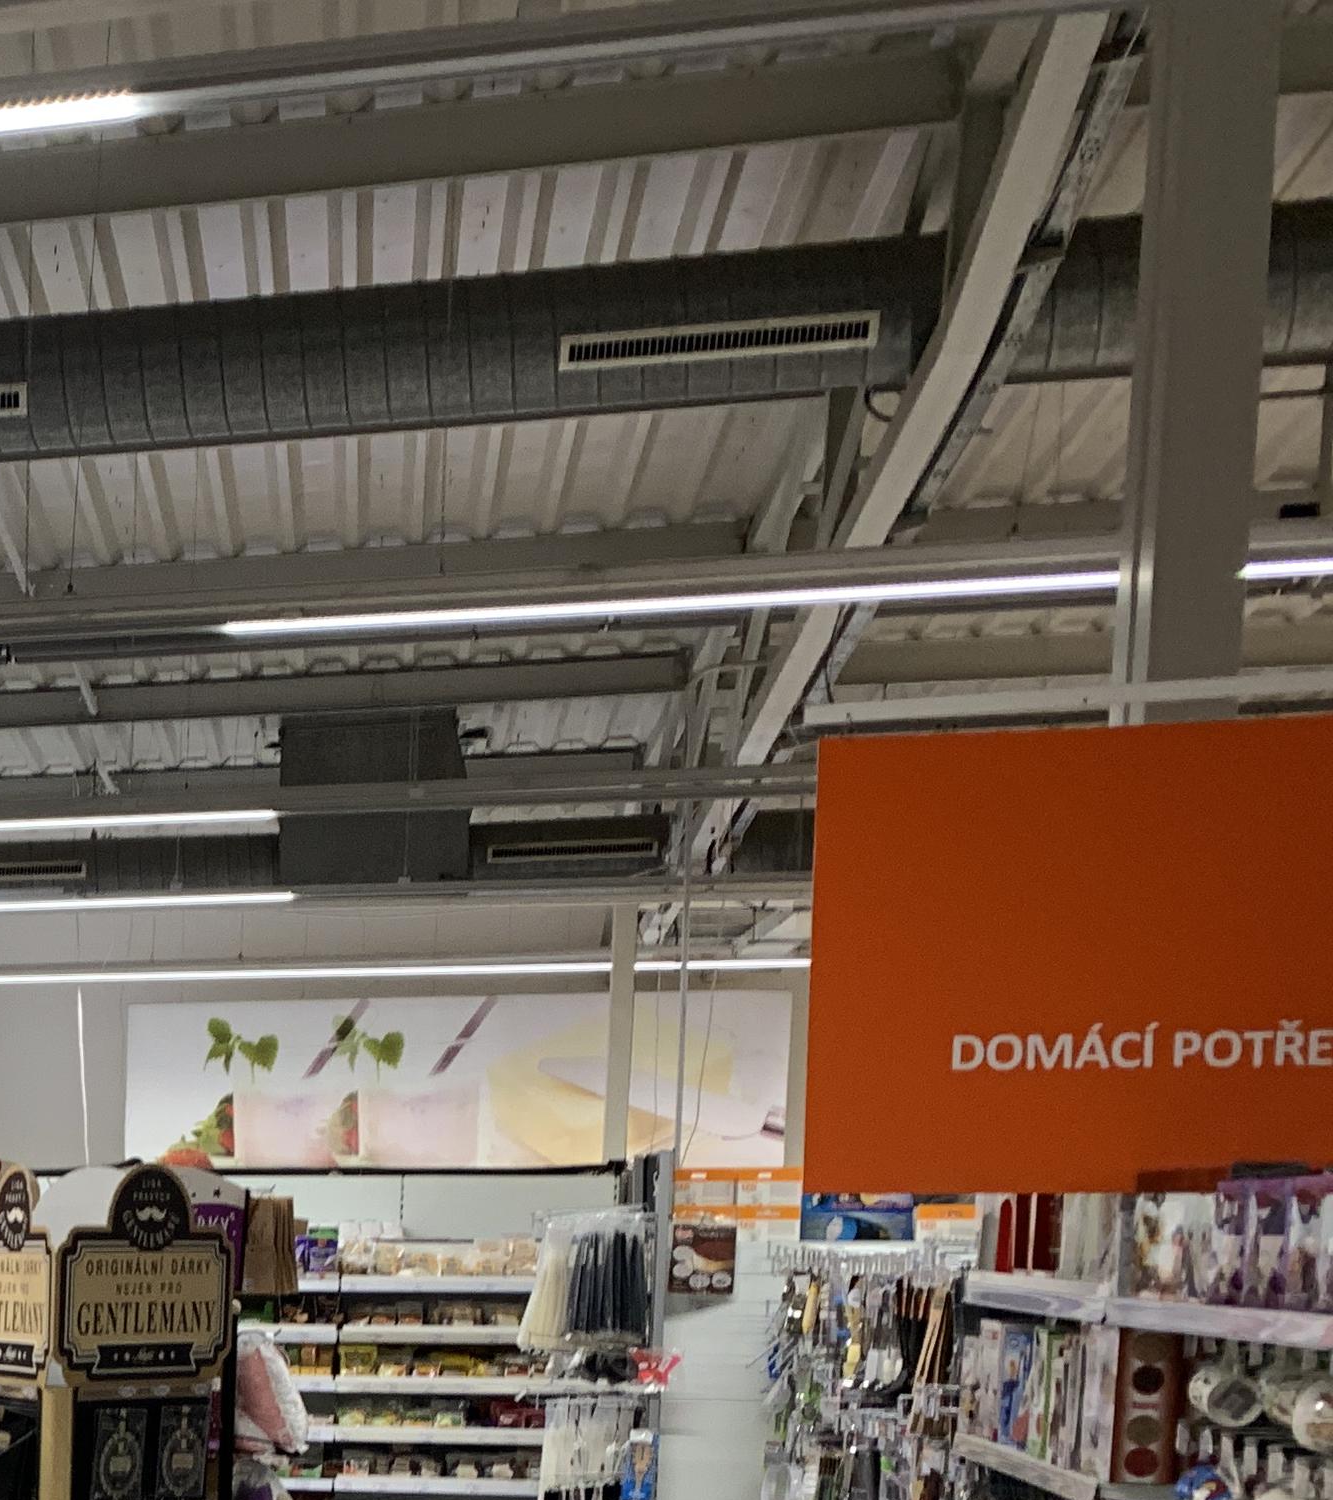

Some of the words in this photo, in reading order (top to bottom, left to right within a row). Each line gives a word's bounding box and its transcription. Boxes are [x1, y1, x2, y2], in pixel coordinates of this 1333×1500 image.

[951, 1021, 1160, 1071] DOMÁCÍ
[85, 1256, 165, 1276] ORIGINÁLNÍ
[171, 1256, 212, 1276] DÁRKY
[116, 1282, 153, 1296] NEJEN
[160, 1281, 183, 1295] PRO
[77, 1300, 216, 1337] GENTLEMANY
